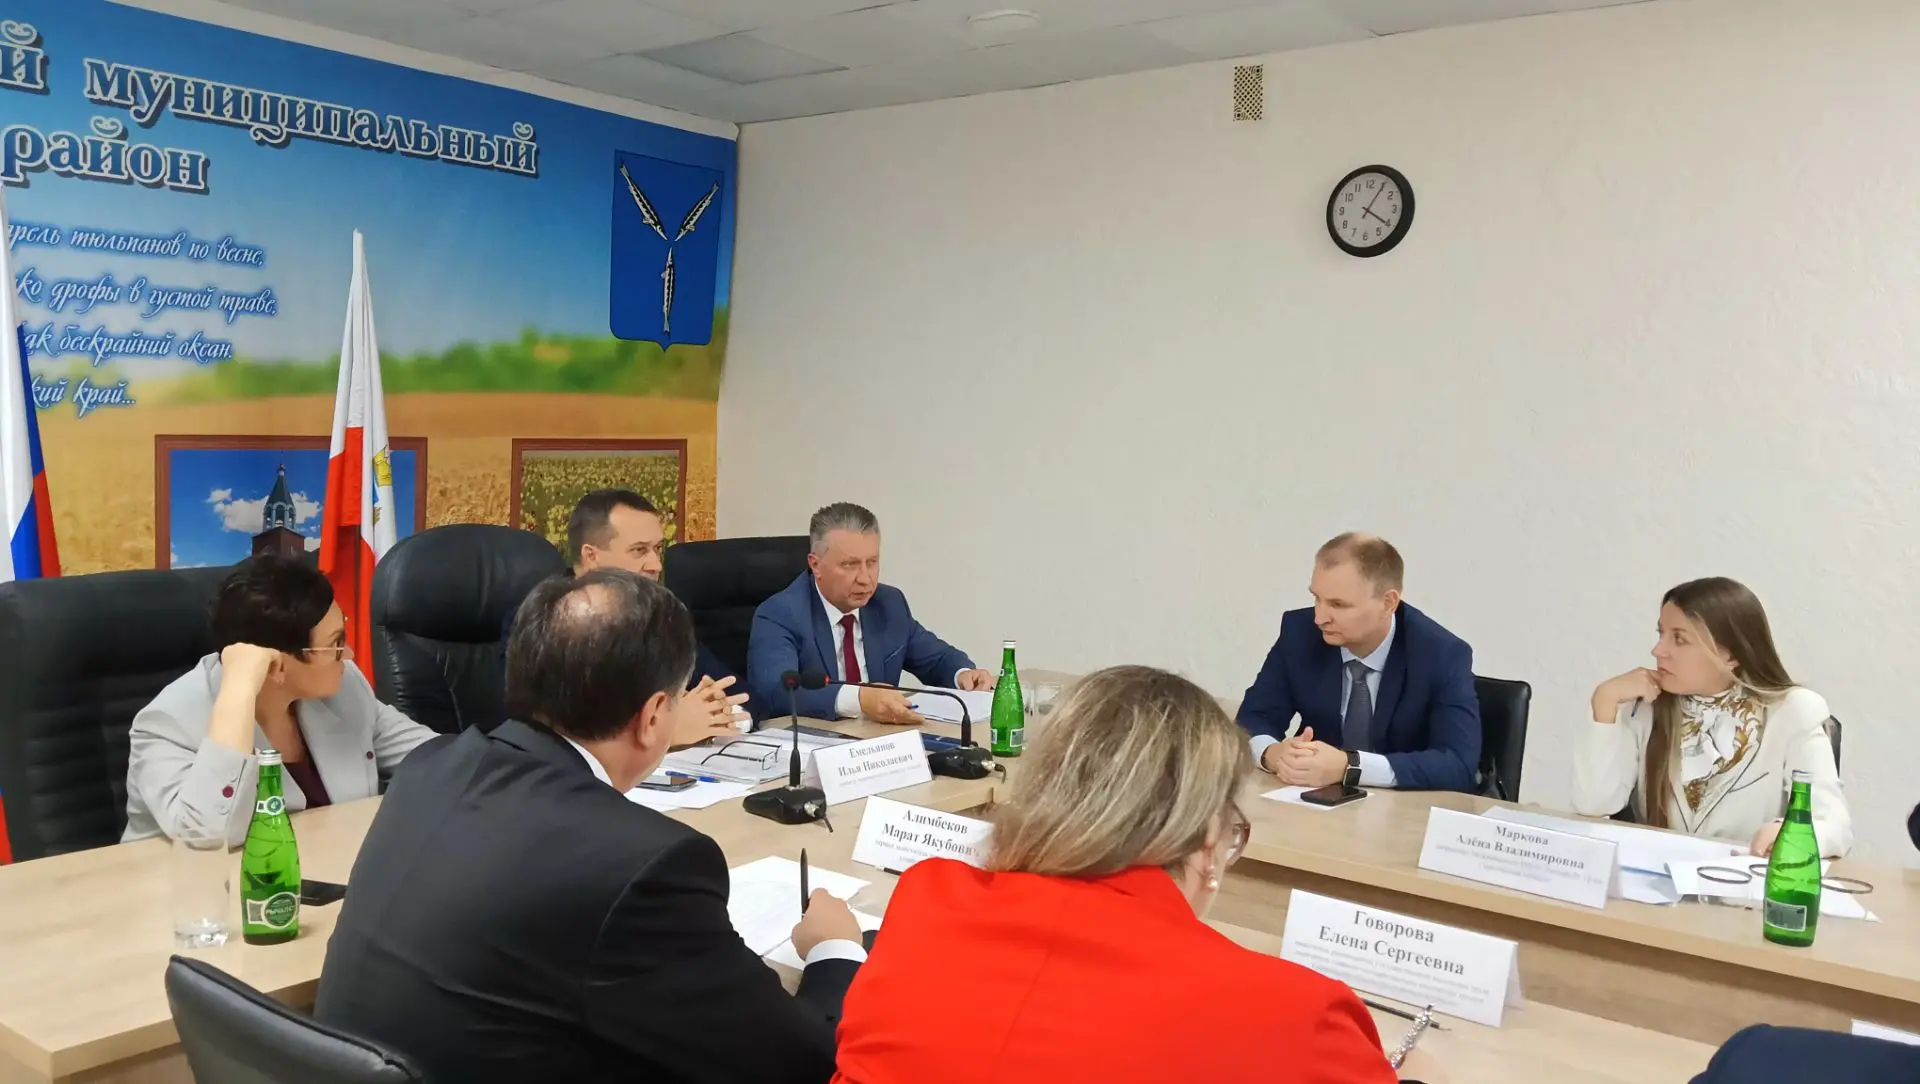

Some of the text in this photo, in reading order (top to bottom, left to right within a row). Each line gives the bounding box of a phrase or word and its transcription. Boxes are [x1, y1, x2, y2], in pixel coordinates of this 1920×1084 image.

[83, 57, 539, 176] муниципальный
[0, 115, 207, 191] район
[1354, 184, 1361, 193] 11
[1365, 180, 1375, 189] 12
[1344, 193, 1354, 202] 10
[1387, 191, 1394, 200] 2
[1338, 206, 1345, 216] 9
[1391, 204, 1398, 213] 3
[1342, 220, 1348, 229] 8
[1351, 227, 1357, 237] 7
[1375, 227, 1382, 236] 5
[70, 230, 186, 256] тюльпанов
[188, 242, 209, 259] по
[1362, 232, 1368, 241] 6
[49, 274, 121, 315] дрофы
[129, 278, 146, 303] в
[141, 287, 216, 318] густой
[59, 324, 177, 367] бескрайний
[178, 331, 233, 364] океан.
[72, 377, 136, 418] край...
[849, 741, 896, 759] Емельянов
[838, 764, 862, 777] Илья
[902, 809, 968, 834] Алимбеков
[882, 823, 920, 842] Марат
[1496, 825, 1549, 846] Маркова
[1456, 834, 1491, 850] Алёна
[1494, 842, 1585, 869] Владимировна
[1353, 909, 1434, 943] Говорова
[1318, 925, 1369, 951] Елена
[1373, 939, 1465, 975] Сергеевна
